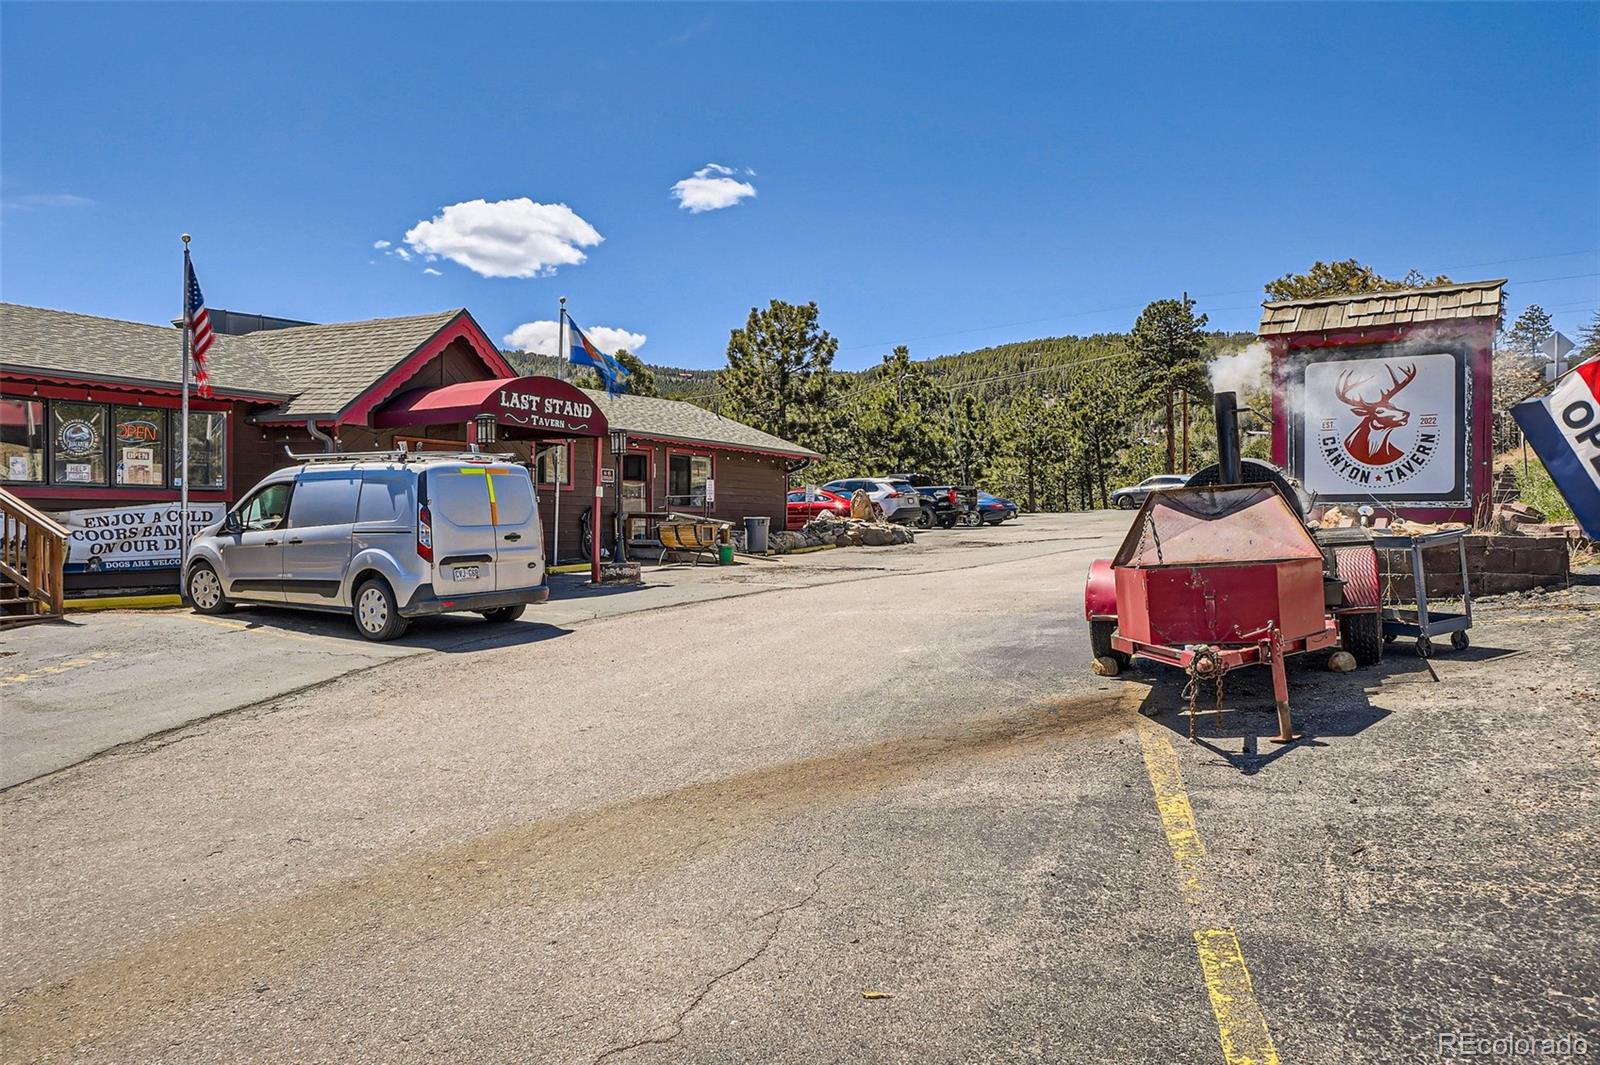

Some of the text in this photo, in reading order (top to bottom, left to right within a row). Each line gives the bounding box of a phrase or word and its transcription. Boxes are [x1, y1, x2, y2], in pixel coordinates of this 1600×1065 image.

[500, 390, 593, 418] LAST STAND
[1420, 417, 1437, 425] 2022
[116, 424, 156, 440] OPEN
[127, 452, 149, 460] OPEN
[1322, 433, 1436, 483] CANYON TAVERN
[84, 512, 146, 528] ENJOY
[152, 512, 162, 523] A
[72, 527, 138, 541] COORS
[90, 542, 117, 555] ON
[120, 540, 160, 553] OUR
[105, 561, 130, 569] DOGS
[132, 560, 151, 568] ARE
